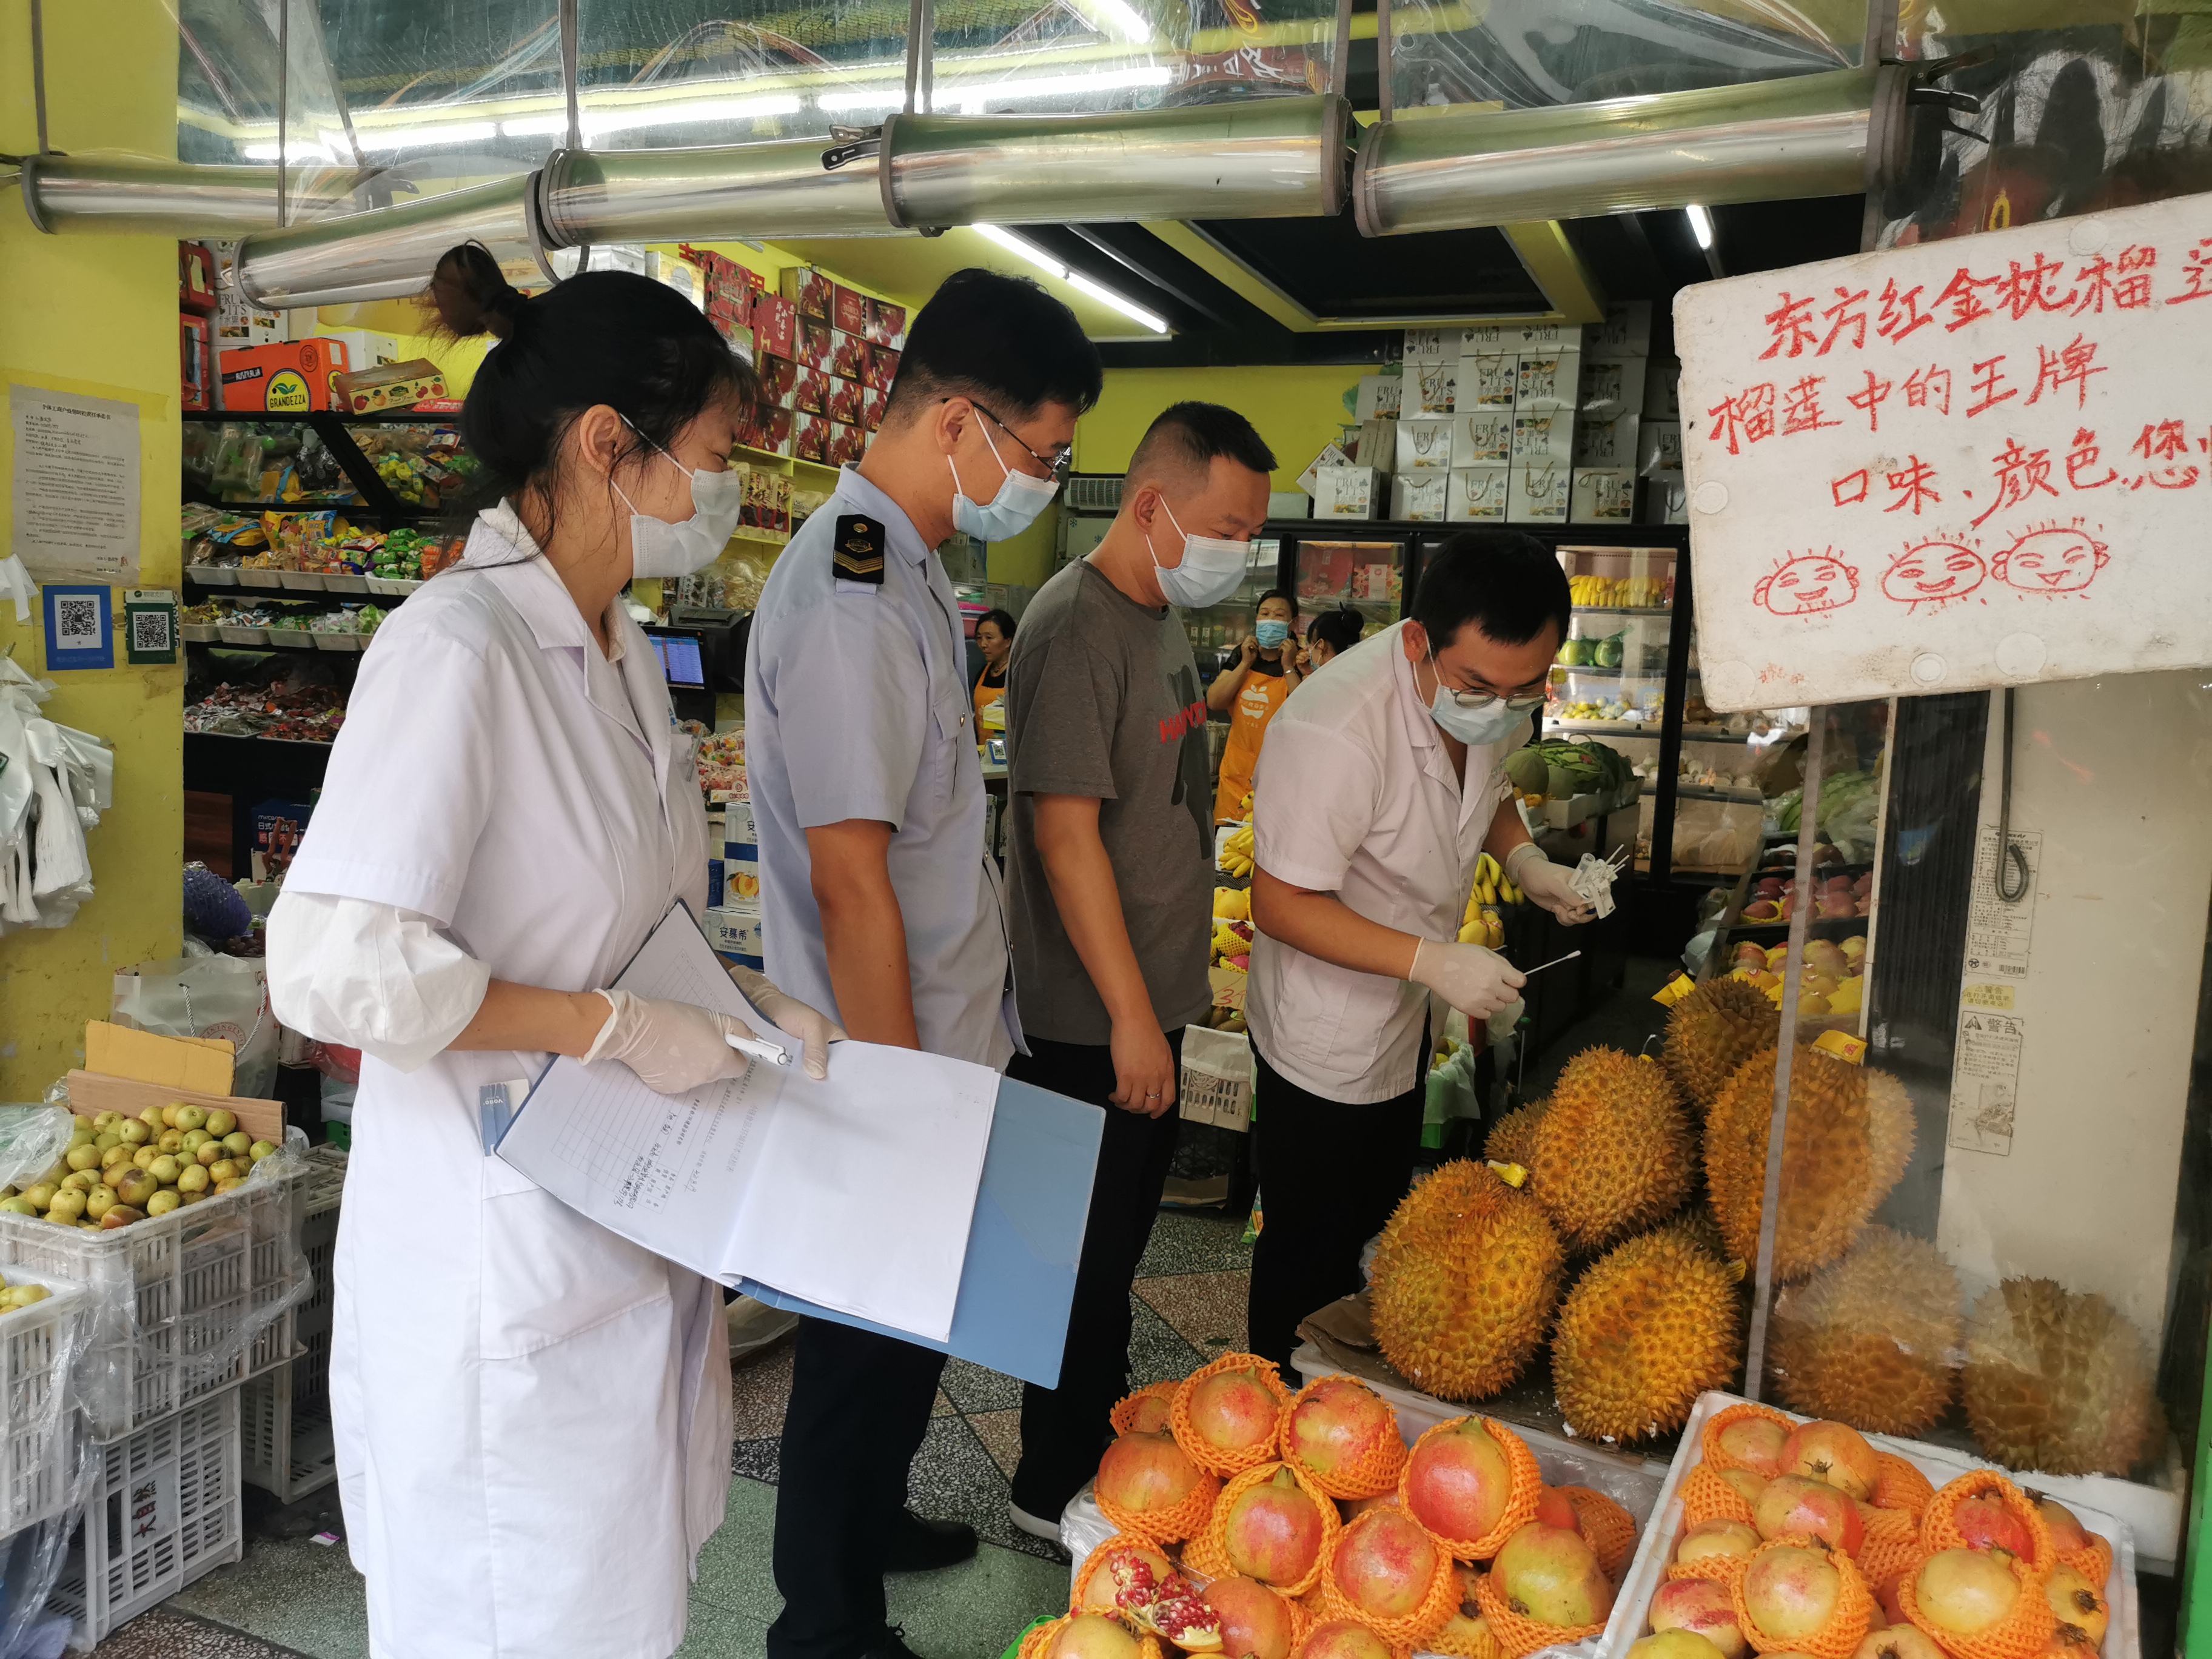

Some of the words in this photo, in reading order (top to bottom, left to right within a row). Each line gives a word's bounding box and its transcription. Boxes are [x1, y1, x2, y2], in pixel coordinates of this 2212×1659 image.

[1489, 377, 1510, 386] ITS
[1708, 333, 2108, 455] 榴莲中的王牌
[270, 394, 306, 408] GRANDEZZA
[1606, 489, 1628, 498] ITS
[720, 927, 747, 940] 安慕希
[1987, 1018, 2016, 1035] 警告
